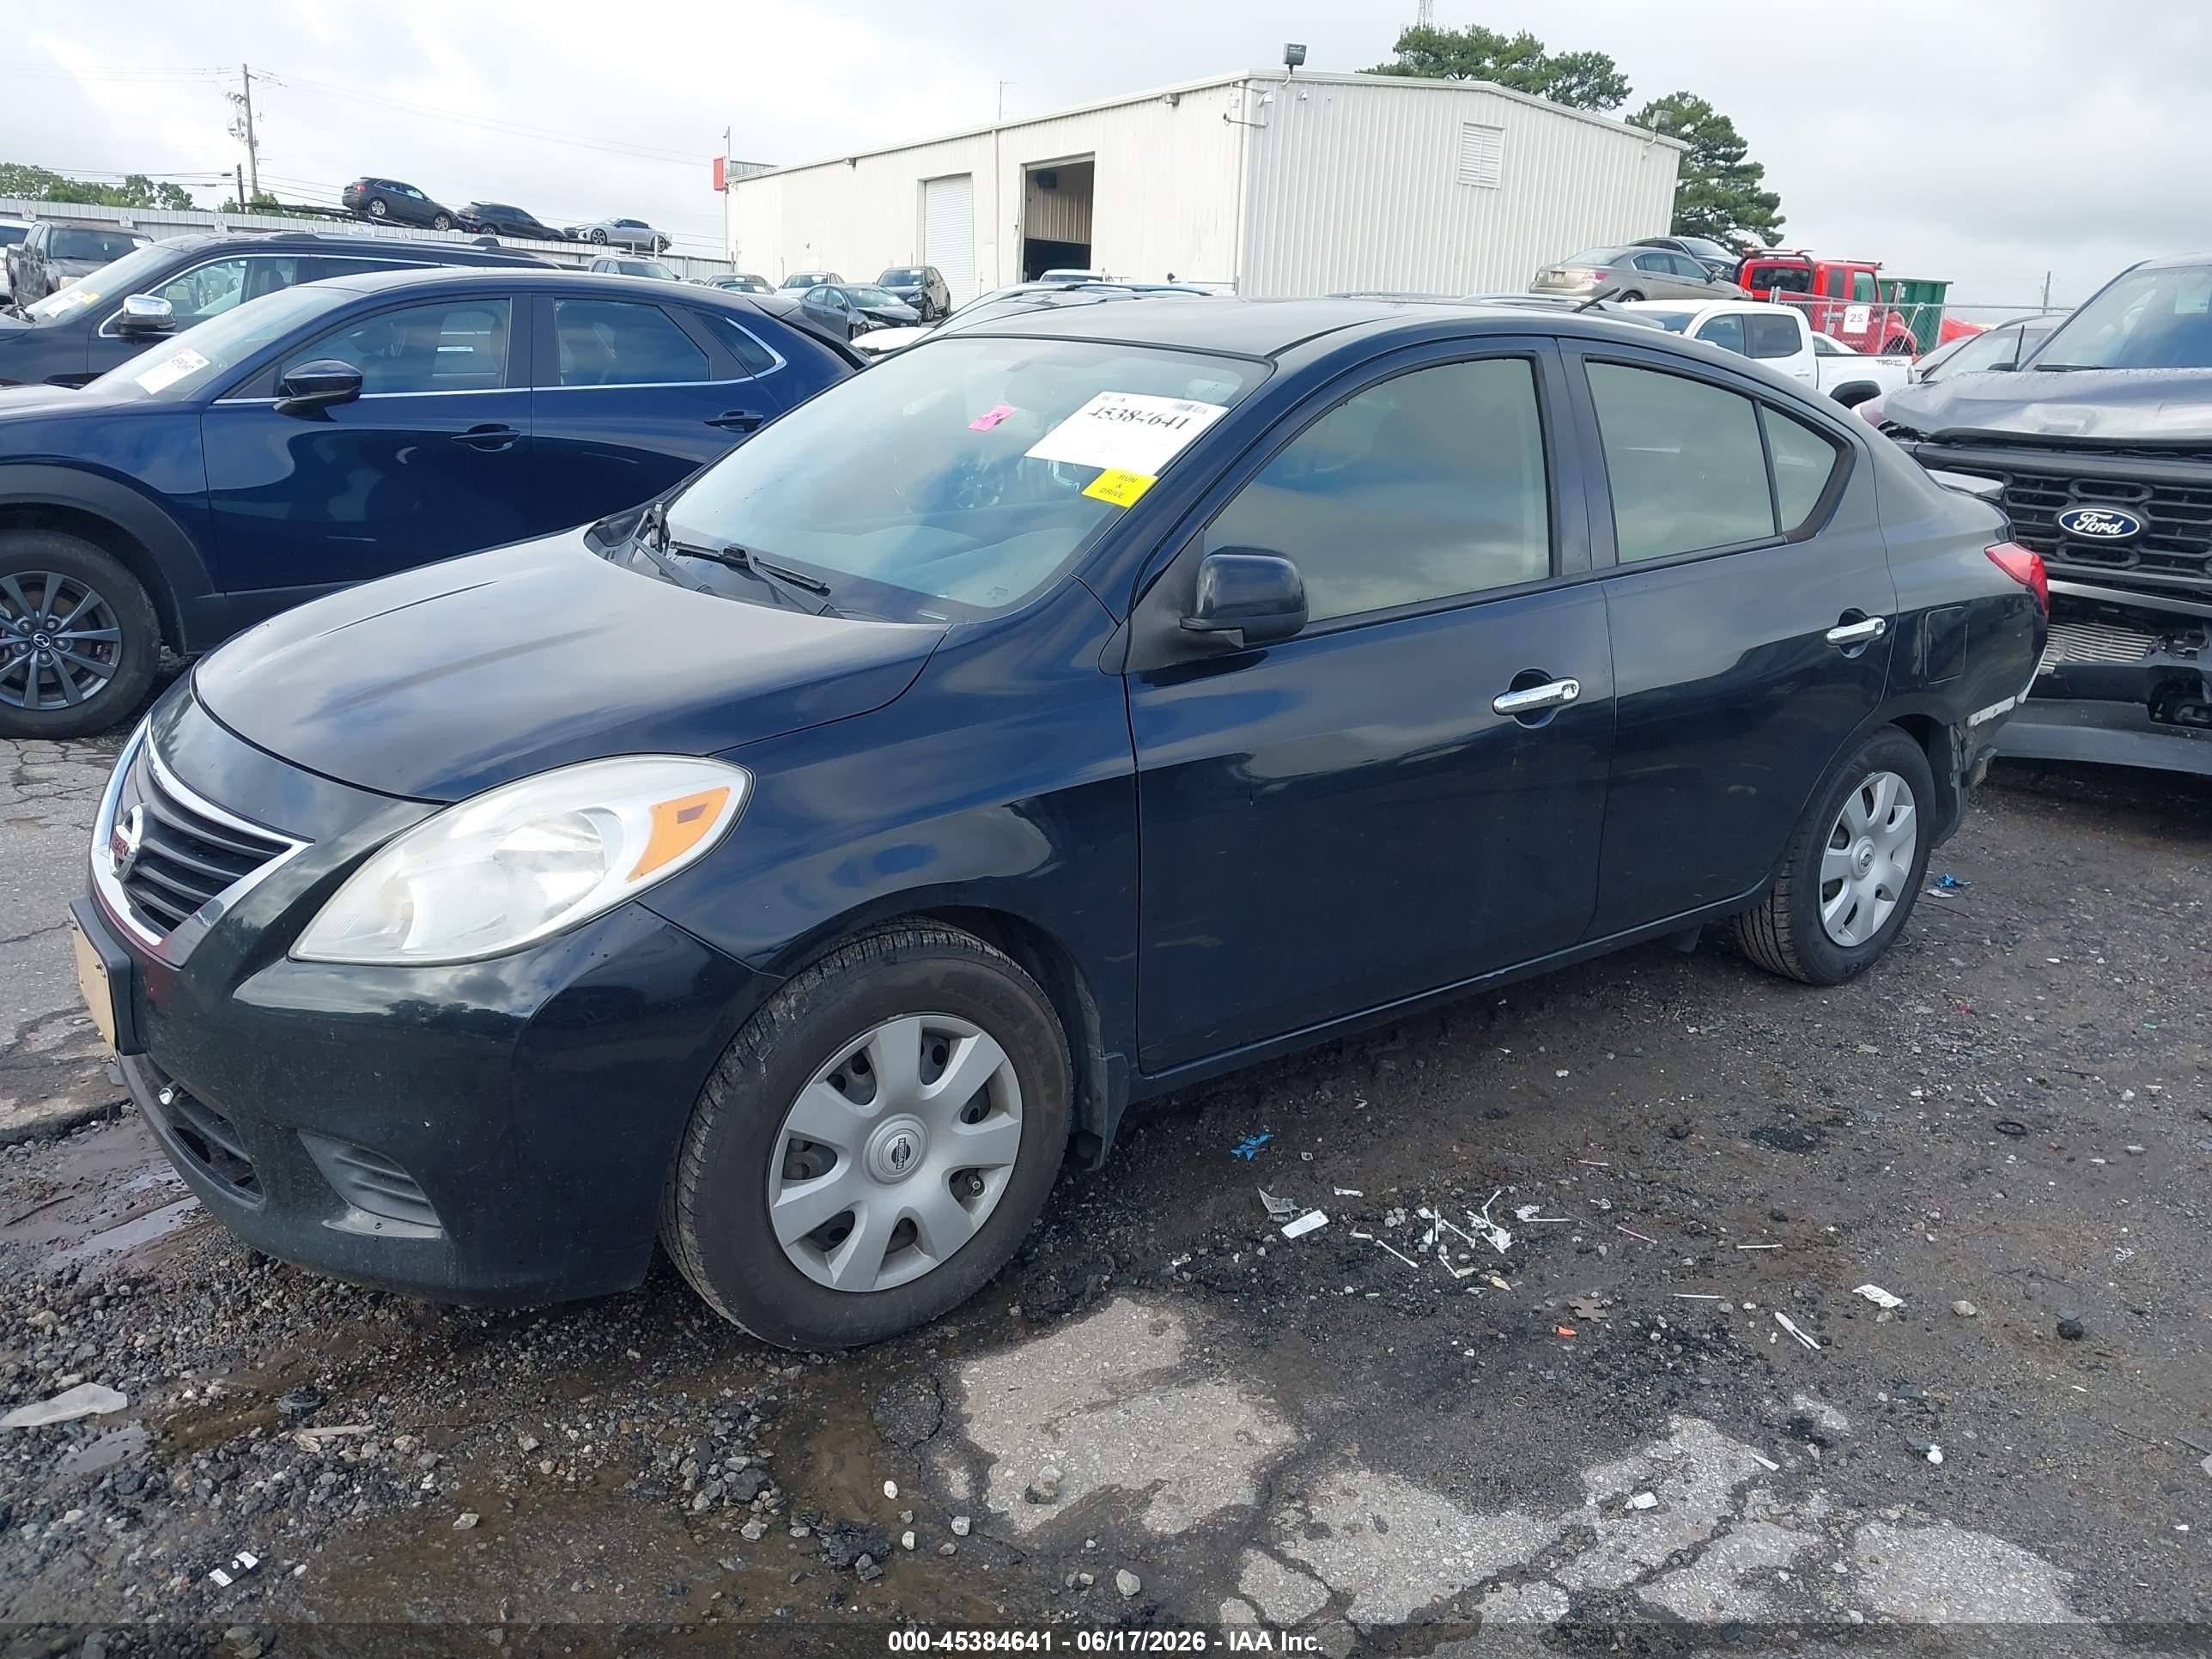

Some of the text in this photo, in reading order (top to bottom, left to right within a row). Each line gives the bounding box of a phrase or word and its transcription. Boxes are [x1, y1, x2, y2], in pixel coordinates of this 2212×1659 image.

[1118, 474, 1138, 484] RUN
[1099, 488, 1126, 499] DRIVE
[2073, 512, 2124, 534] Ford
